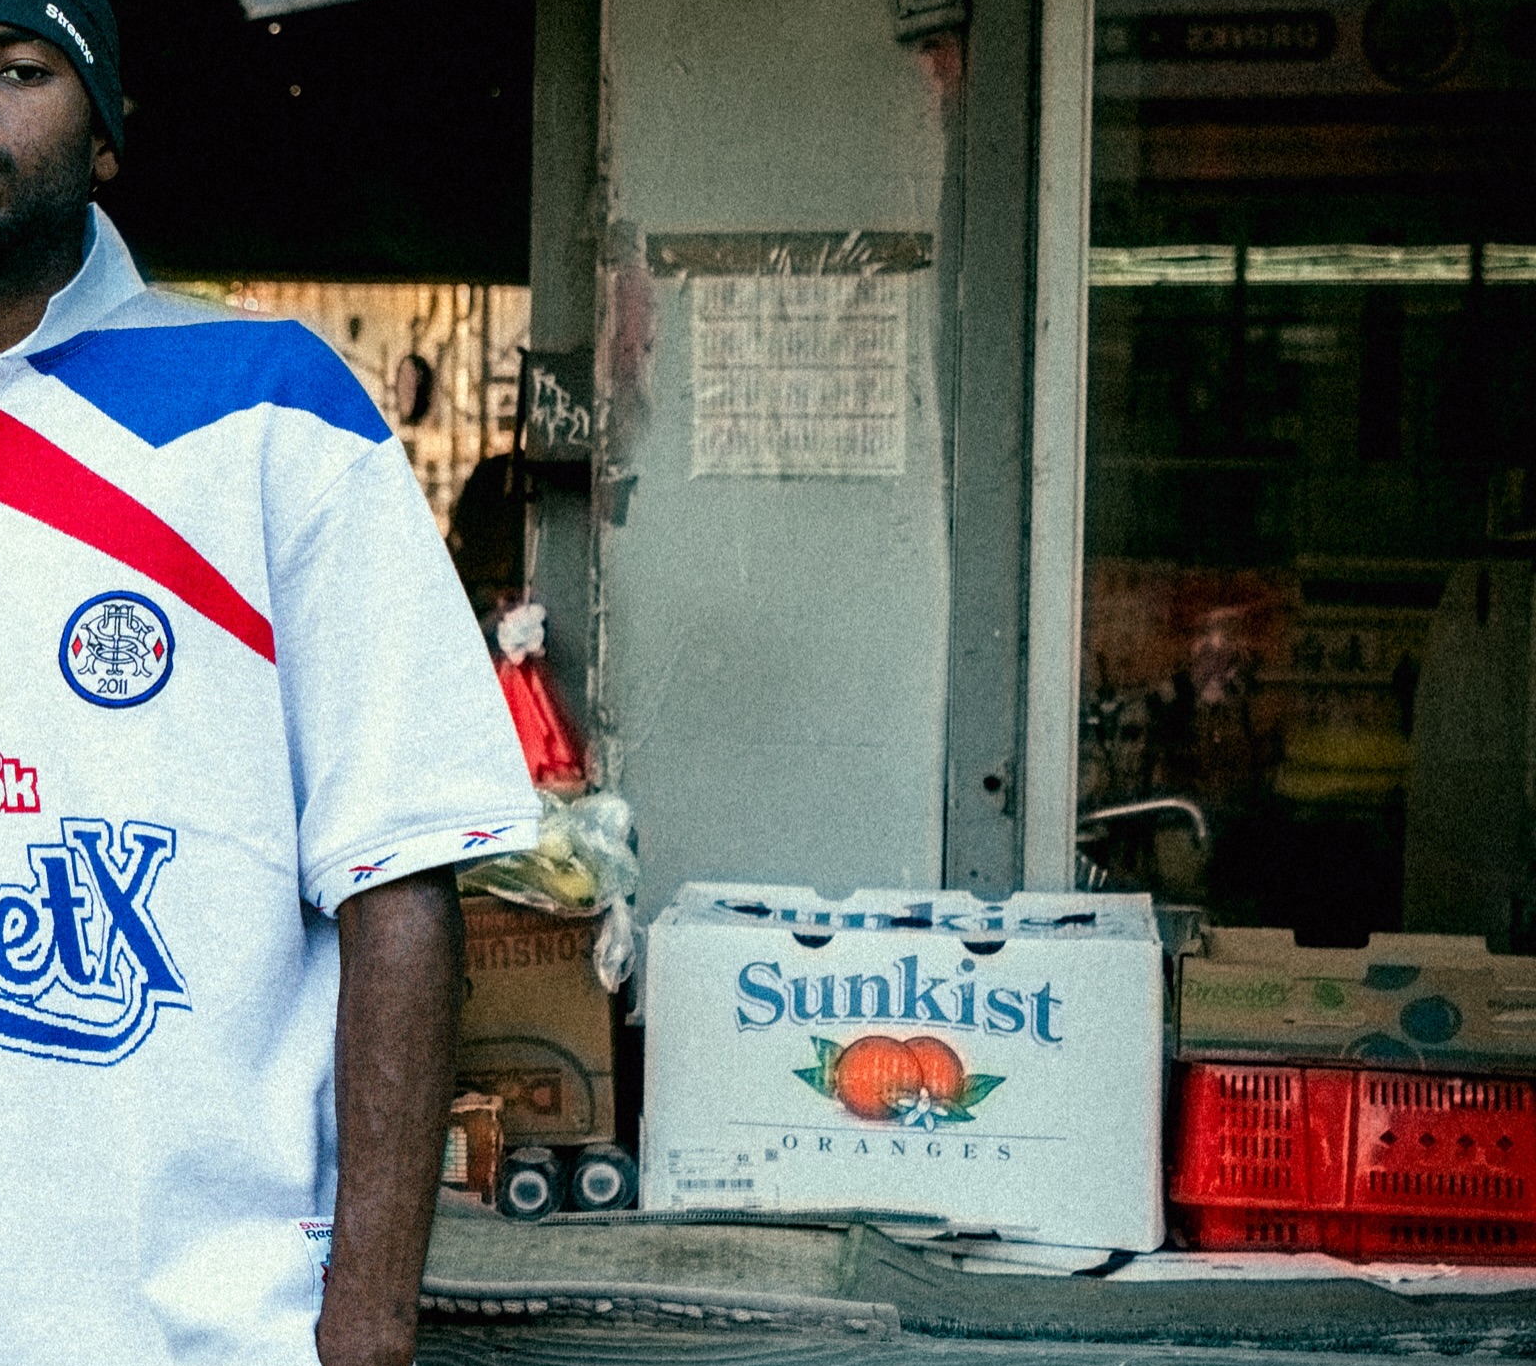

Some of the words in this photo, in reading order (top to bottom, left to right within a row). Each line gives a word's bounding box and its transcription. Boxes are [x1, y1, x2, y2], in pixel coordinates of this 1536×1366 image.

[96, 677, 129, 696] 2011
[734, 954, 1063, 1047] Sunkist
[782, 1134, 1012, 1161] ORANGES
